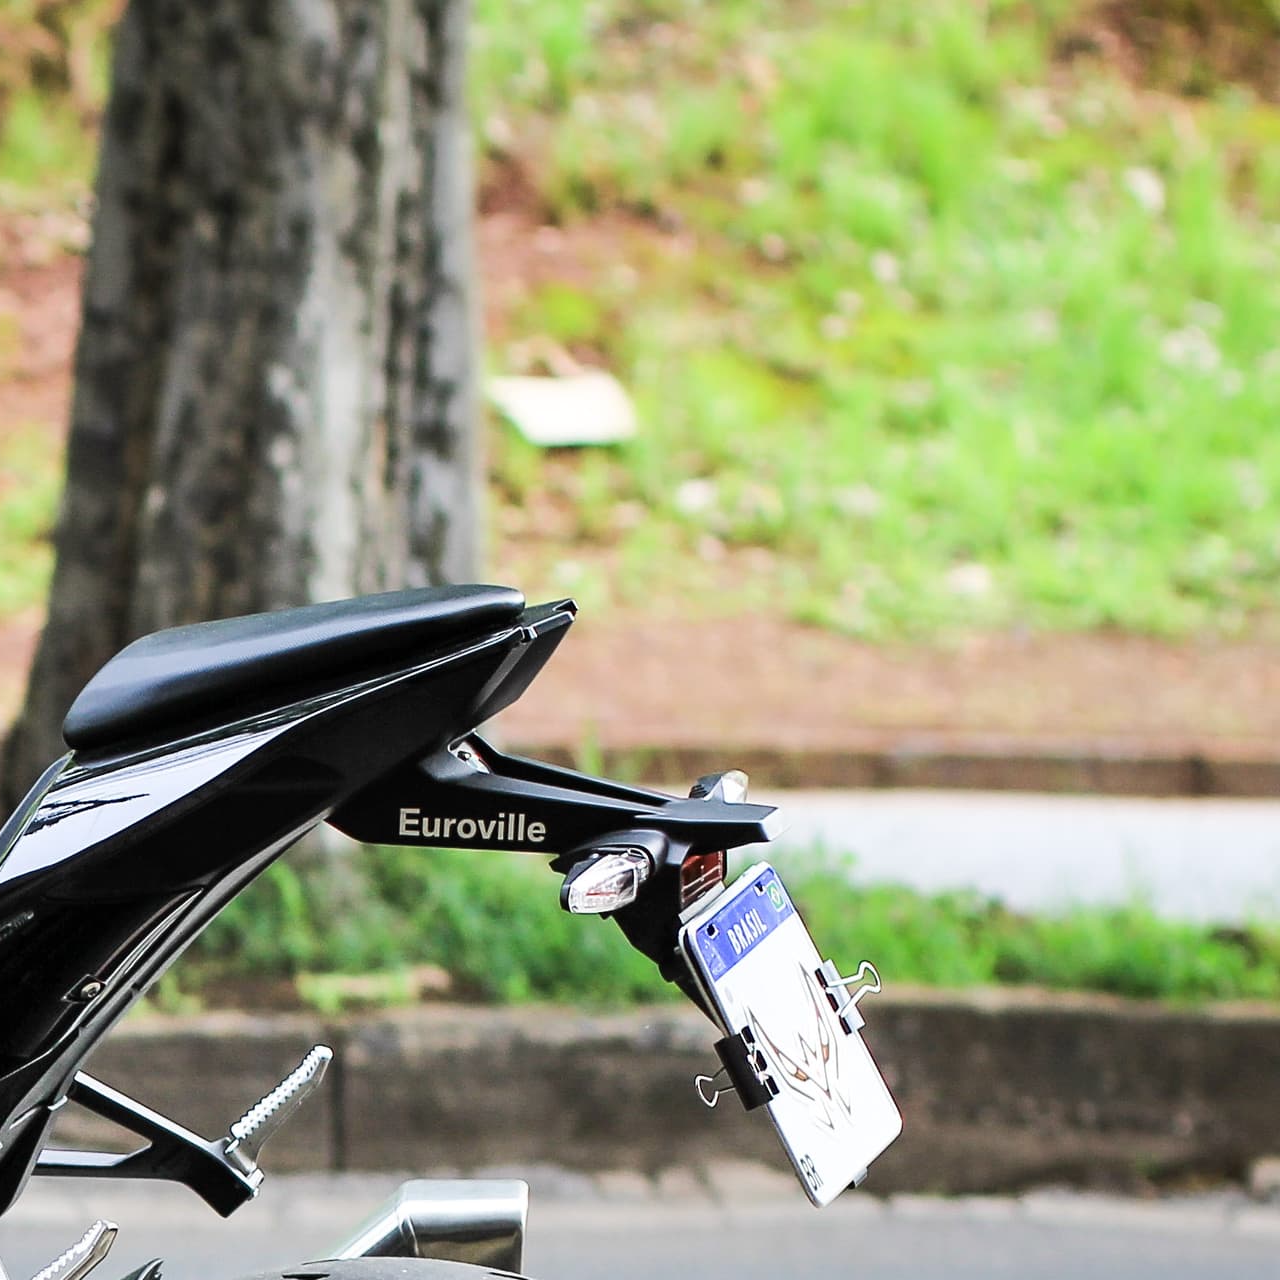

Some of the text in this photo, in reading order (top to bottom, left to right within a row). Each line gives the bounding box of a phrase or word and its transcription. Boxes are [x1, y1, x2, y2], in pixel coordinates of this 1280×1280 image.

[399, 808, 547, 842] Euroville
[727, 908, 767, 955] BRASIL
[800, 1154, 824, 1190] BR
